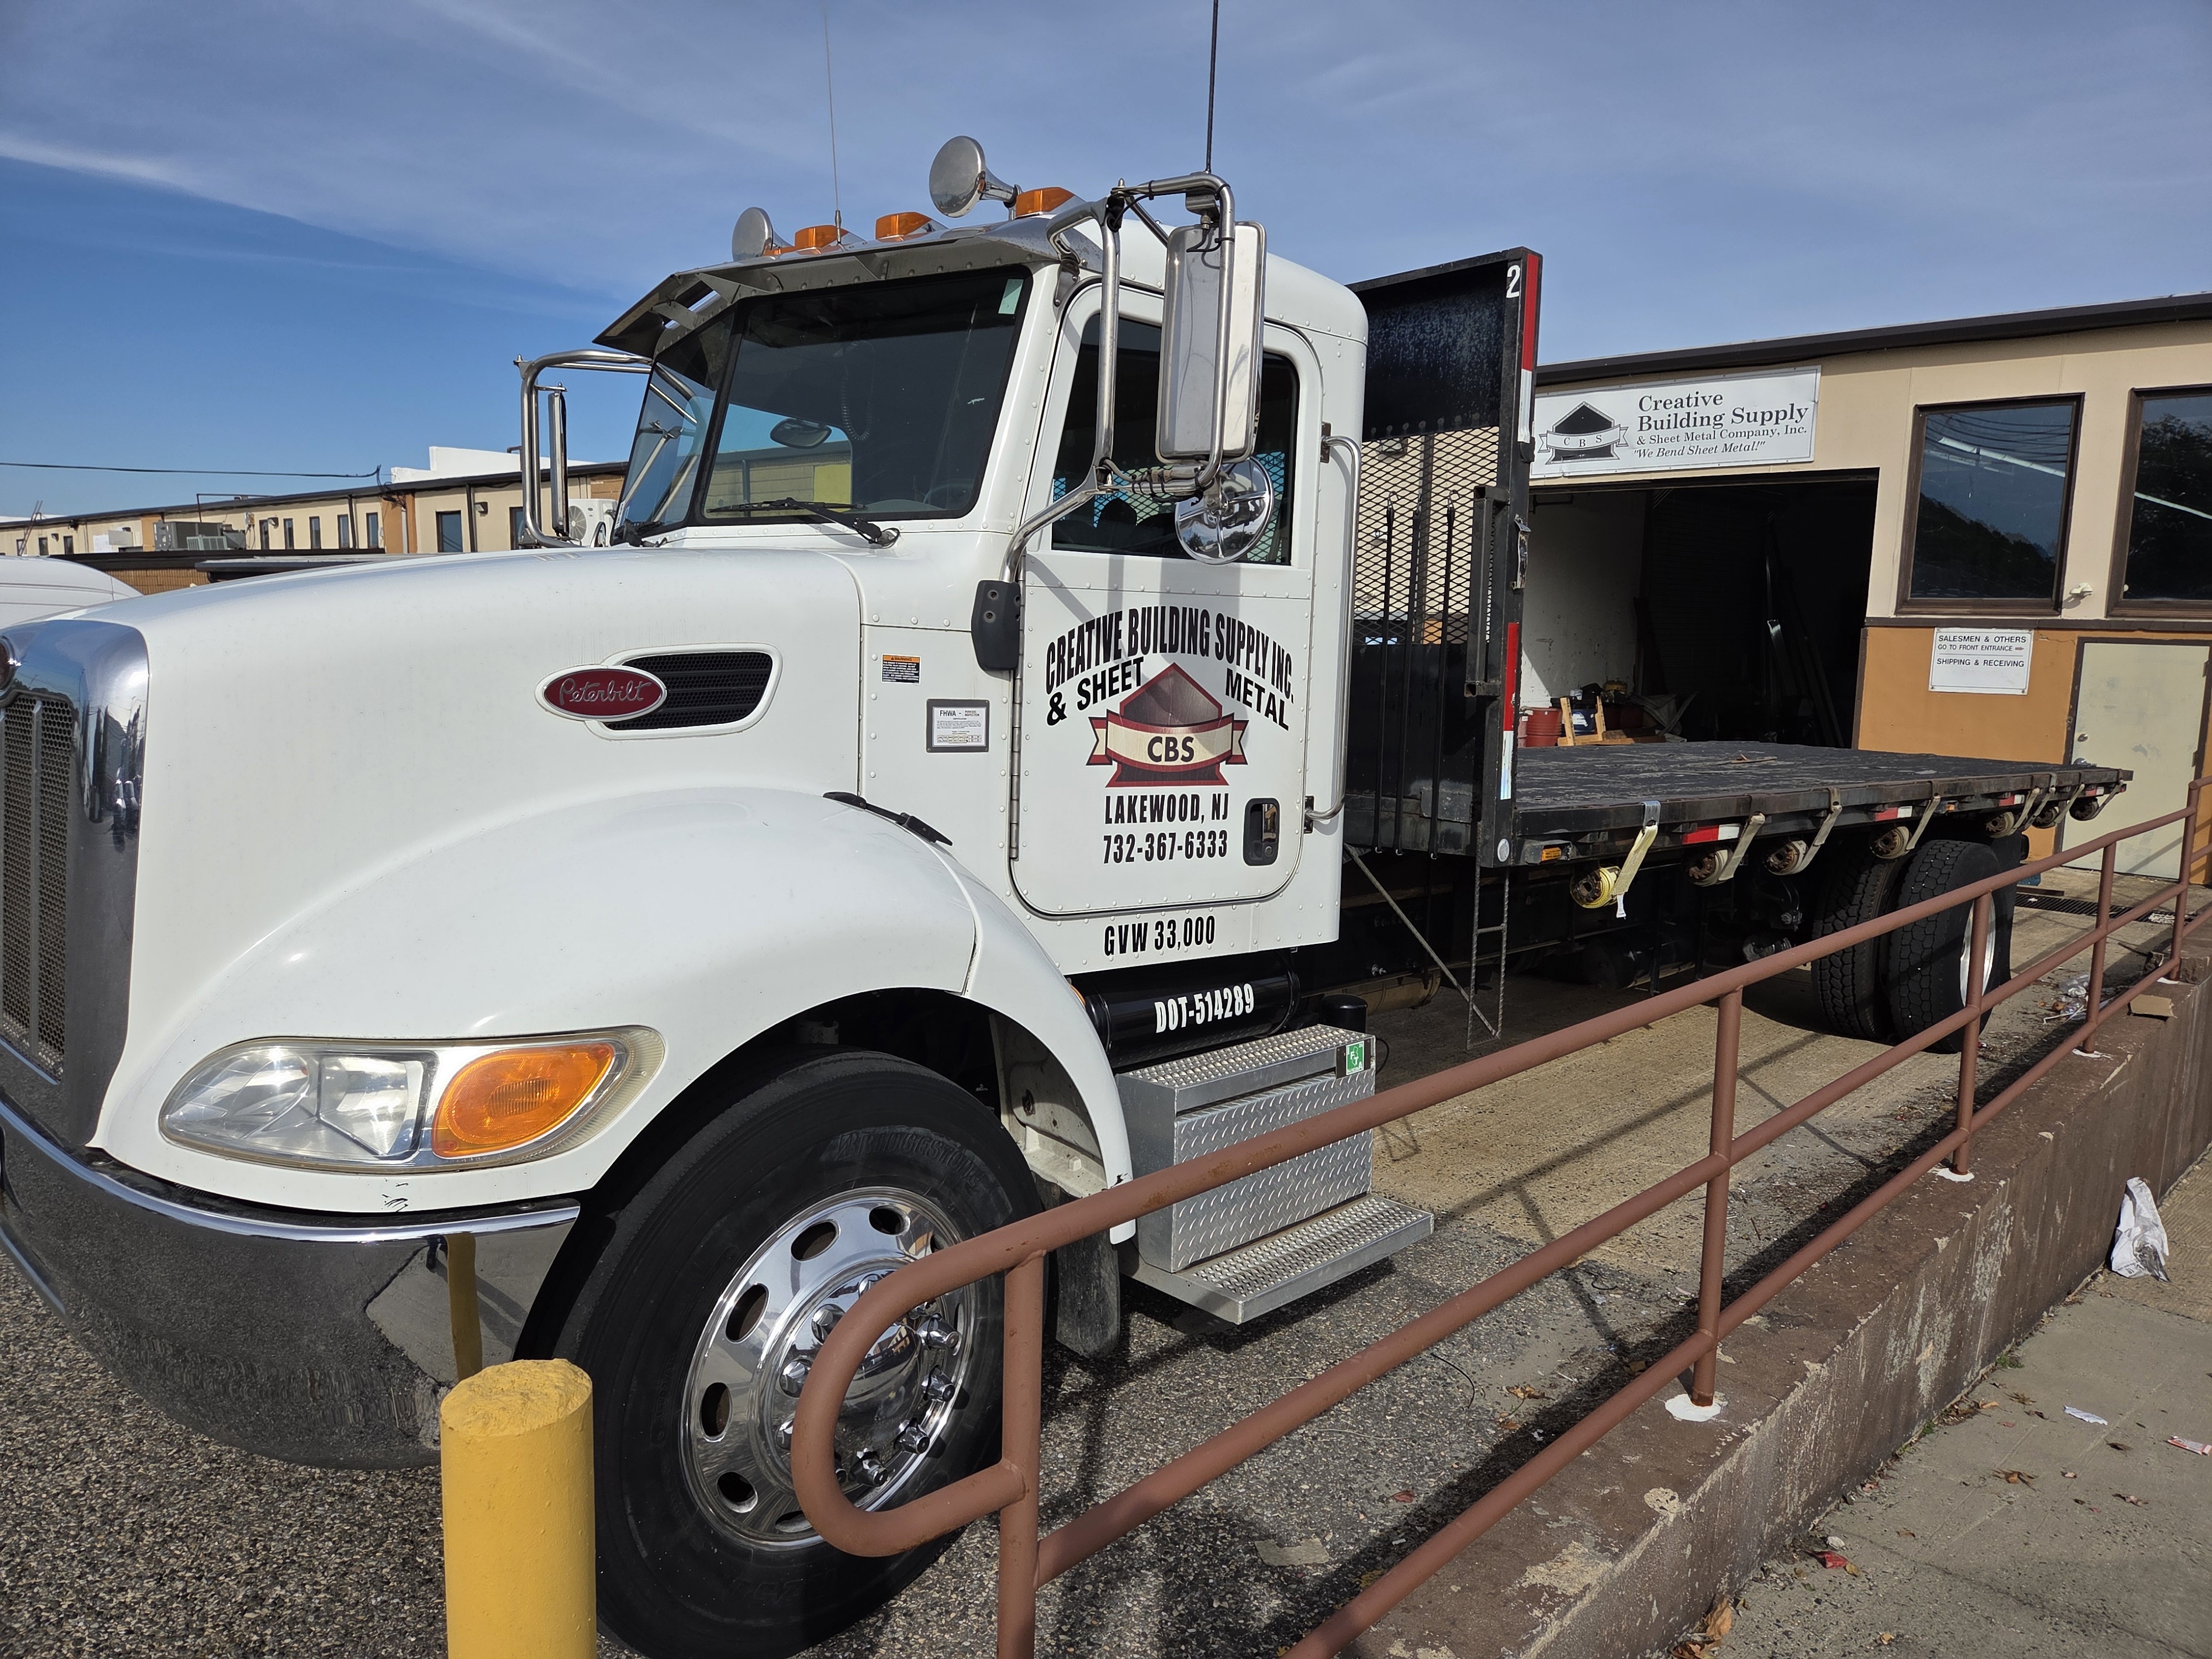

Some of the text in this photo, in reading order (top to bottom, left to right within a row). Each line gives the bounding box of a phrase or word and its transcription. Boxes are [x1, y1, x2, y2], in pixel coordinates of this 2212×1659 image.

[1506, 264, 1520, 298] 2
[1638, 391, 1723, 411] Creative
[1637, 403, 1809, 432] Building Supply
[1634, 440, 1766, 459] "We Bend Sheet Metal!"
[1636, 424, 1807, 445] & Sheet Metal Company, Inc.
[1046, 606, 1294, 705] CREATIVE BUILDING SUPPLY INC.
[1937, 658, 1971, 666] SHIPPING
[1983, 659, 2025, 667] RECEIVING
[559, 677, 652, 706] Peterbilt
[1046, 656, 1289, 731] & SHEET METAL
[1147, 735, 1194, 763] CBS
[1104, 792, 1229, 824] LAKEWOOD, NJ
[1103, 830, 1228, 864] 732-367-6333
[1104, 915, 1215, 956] GVW 33,000
[1154, 983, 1254, 1034] DOT-514289
[834, 1133, 980, 1187] BRIDGESTONE
